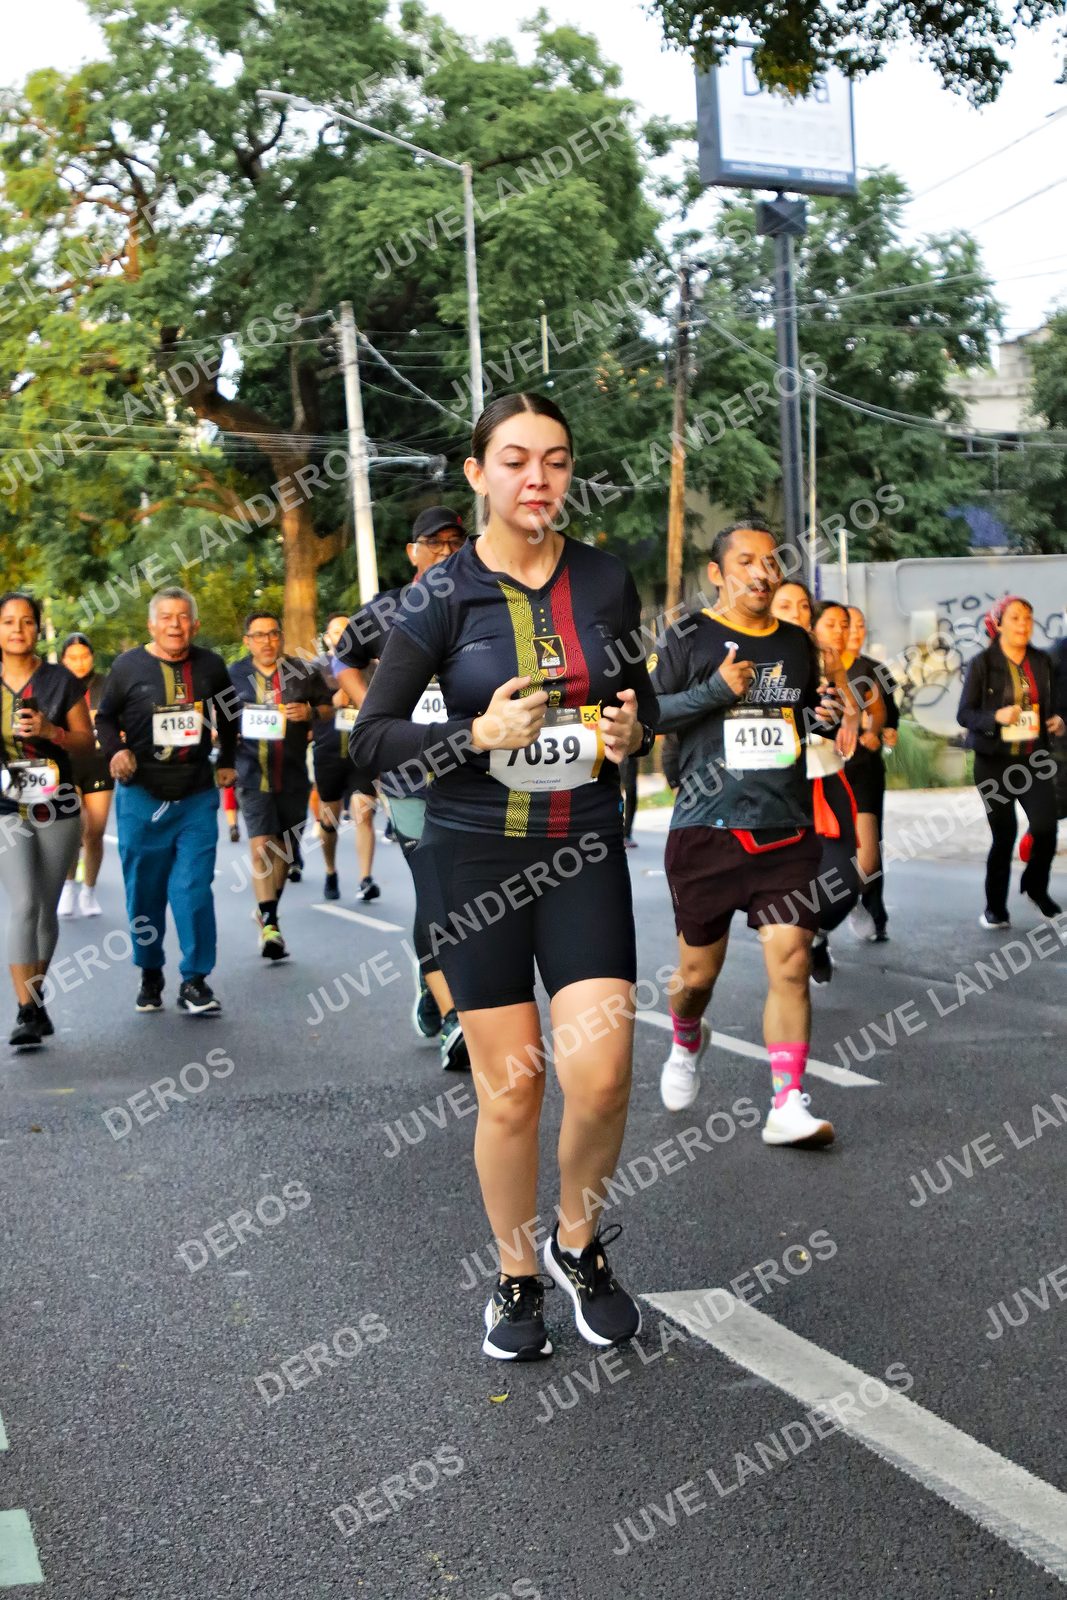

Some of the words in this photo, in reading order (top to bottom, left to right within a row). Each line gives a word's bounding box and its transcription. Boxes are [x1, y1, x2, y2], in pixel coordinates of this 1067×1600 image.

[740, 687, 801, 703] UNNERS
[421, 697, 447, 713] 40
[160, 716, 194, 731] 4188
[735, 726, 784, 746] 4102
